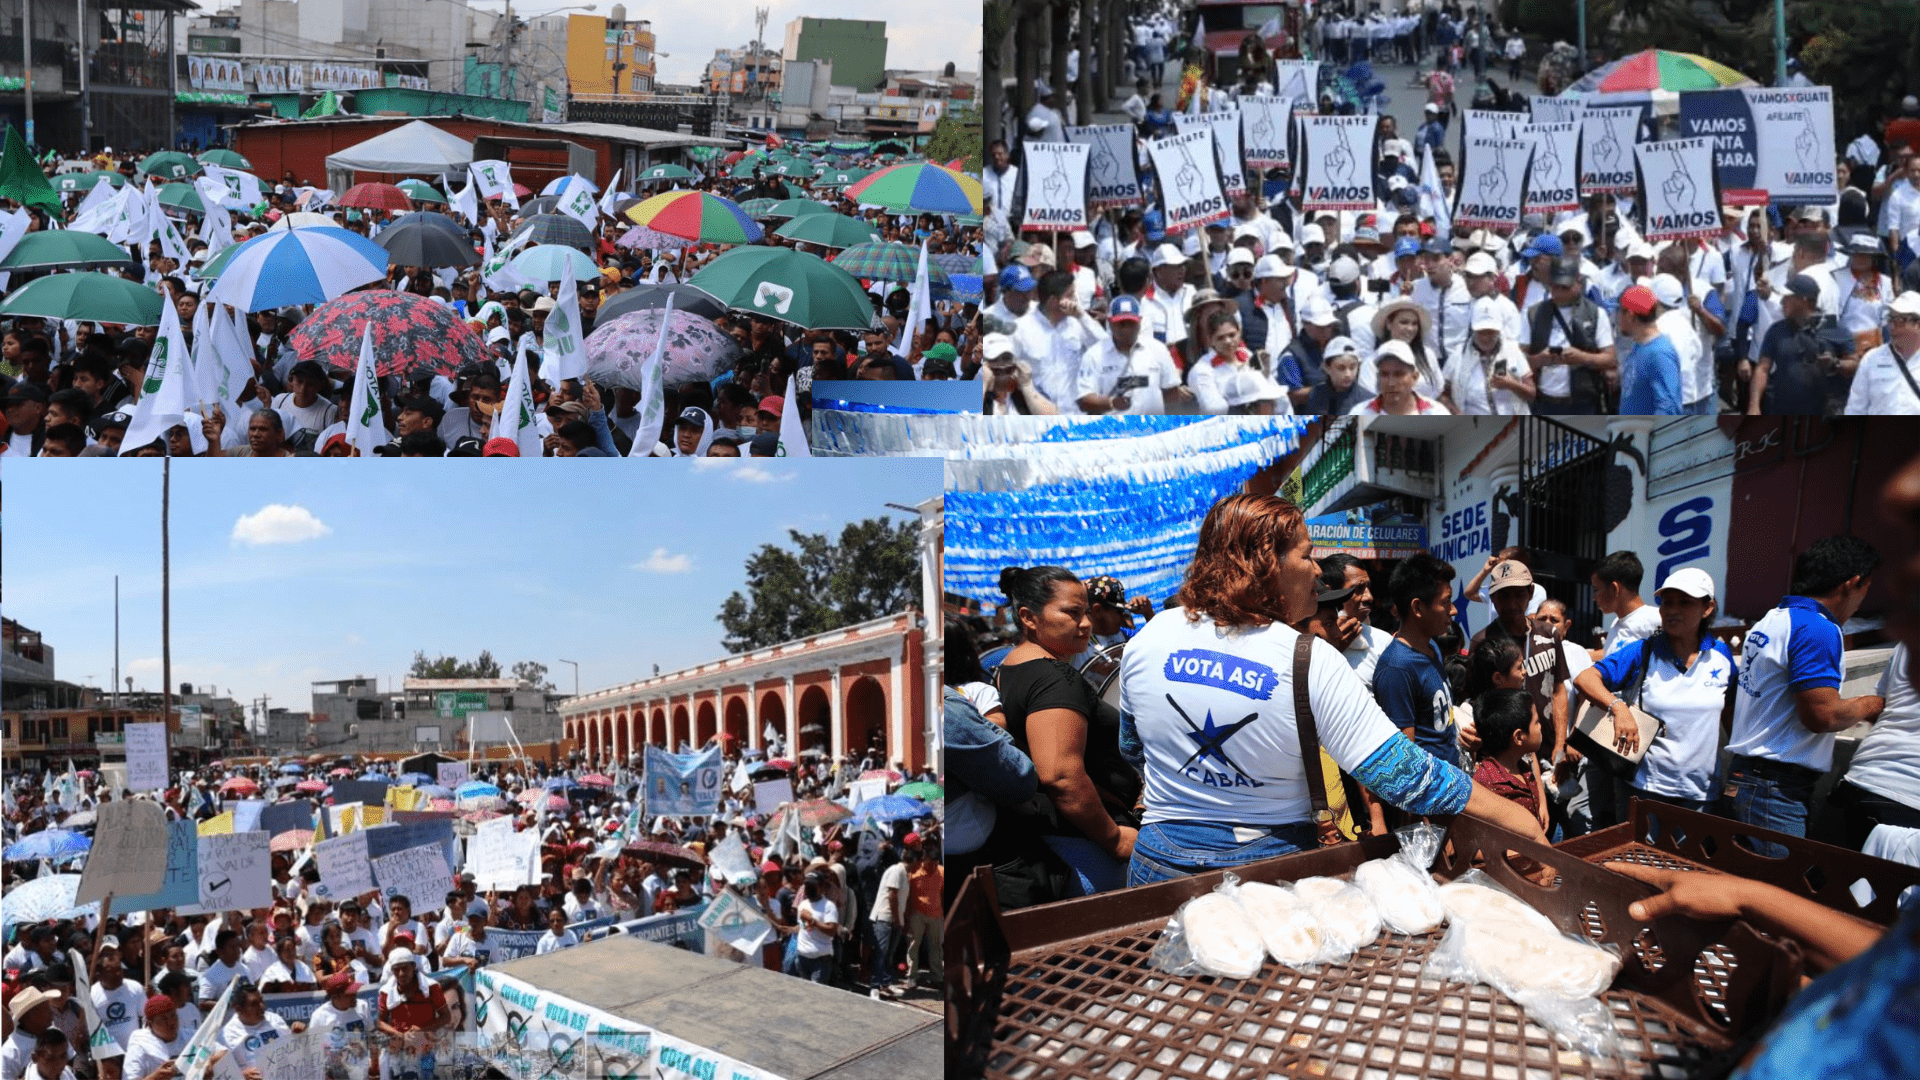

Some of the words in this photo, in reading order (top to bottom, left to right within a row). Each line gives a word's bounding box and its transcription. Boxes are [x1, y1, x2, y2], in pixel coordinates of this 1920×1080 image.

[1751, 92, 1829, 104] VAMOSXGUATE
[1690, 118, 1747, 133] VAMOS
[1715, 136, 1744, 150] NTA
[1716, 153, 1755, 167] BARA
[1785, 172, 1833, 185] VAMOS
[1090, 183, 1136, 198] AMOS
[1309, 186, 1370, 201] VAMOS
[1527, 188, 1574, 203] AMOS
[1029, 208, 1082, 222] VAMOS
[1168, 195, 1223, 222] VAMOS
[1460, 204, 1518, 219] VAMOS
[1651, 210, 1716, 231] VAMOS
[366, 365, 380, 396] OTA
[1441, 501, 1487, 539] SEDE
[1308, 523, 1350, 539] ARACIÓN
[1353, 526, 1366, 539] DE
[1368, 527, 1420, 541] CELULARES
[1430, 527, 1491, 562] MUNICIPA
[1521, 647, 1557, 678] UMA
[1172, 656, 1224, 680] VOTA
[1229, 667, 1265, 691] ASÍ
[1185, 766, 1265, 789] CABAL
[545, 1002, 570, 1026] VOTA
[660, 1046, 691, 1074] VOTA
